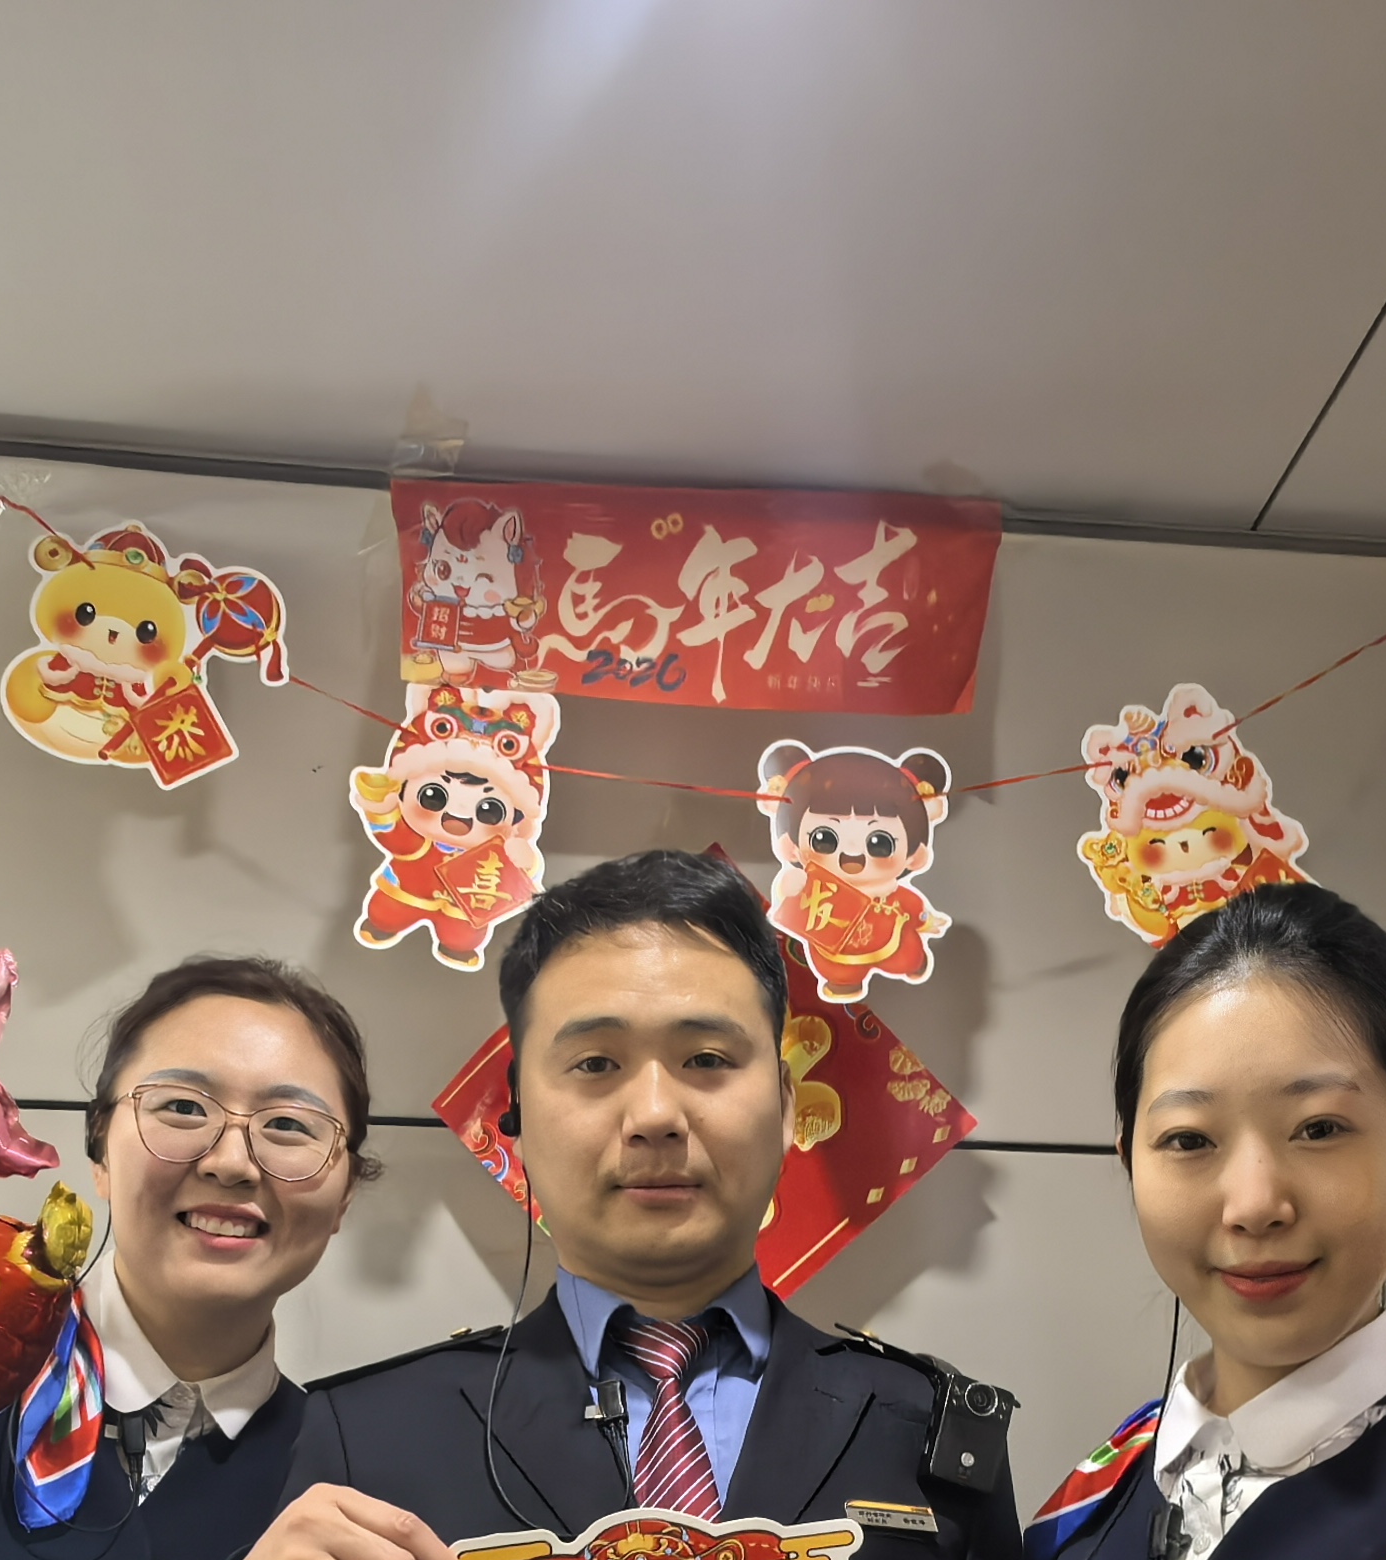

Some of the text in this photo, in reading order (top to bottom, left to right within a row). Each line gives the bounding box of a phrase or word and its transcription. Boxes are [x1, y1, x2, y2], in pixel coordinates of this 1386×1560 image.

[581, 649, 687, 692] 2026
[456, 850, 513, 911] 喜
[799, 879, 850, 932] 发
